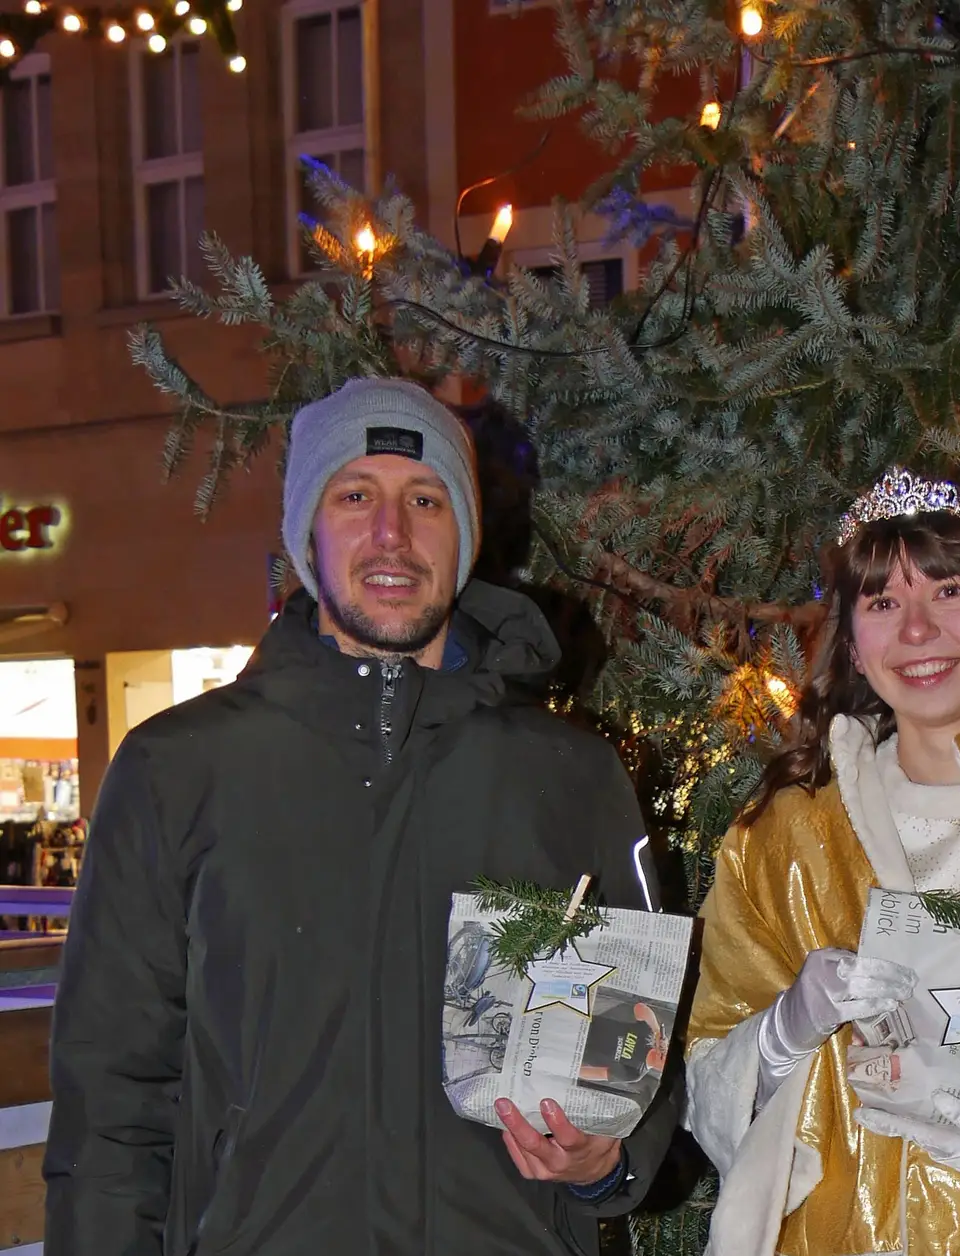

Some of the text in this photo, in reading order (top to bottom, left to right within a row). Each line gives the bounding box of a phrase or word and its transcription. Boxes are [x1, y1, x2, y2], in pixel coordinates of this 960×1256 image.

[0, 506, 61, 551] er
[876, 890, 901, 937] kblick
[530, 1019, 542, 1036] von
[621, 1031, 638, 1061] LAYLA
